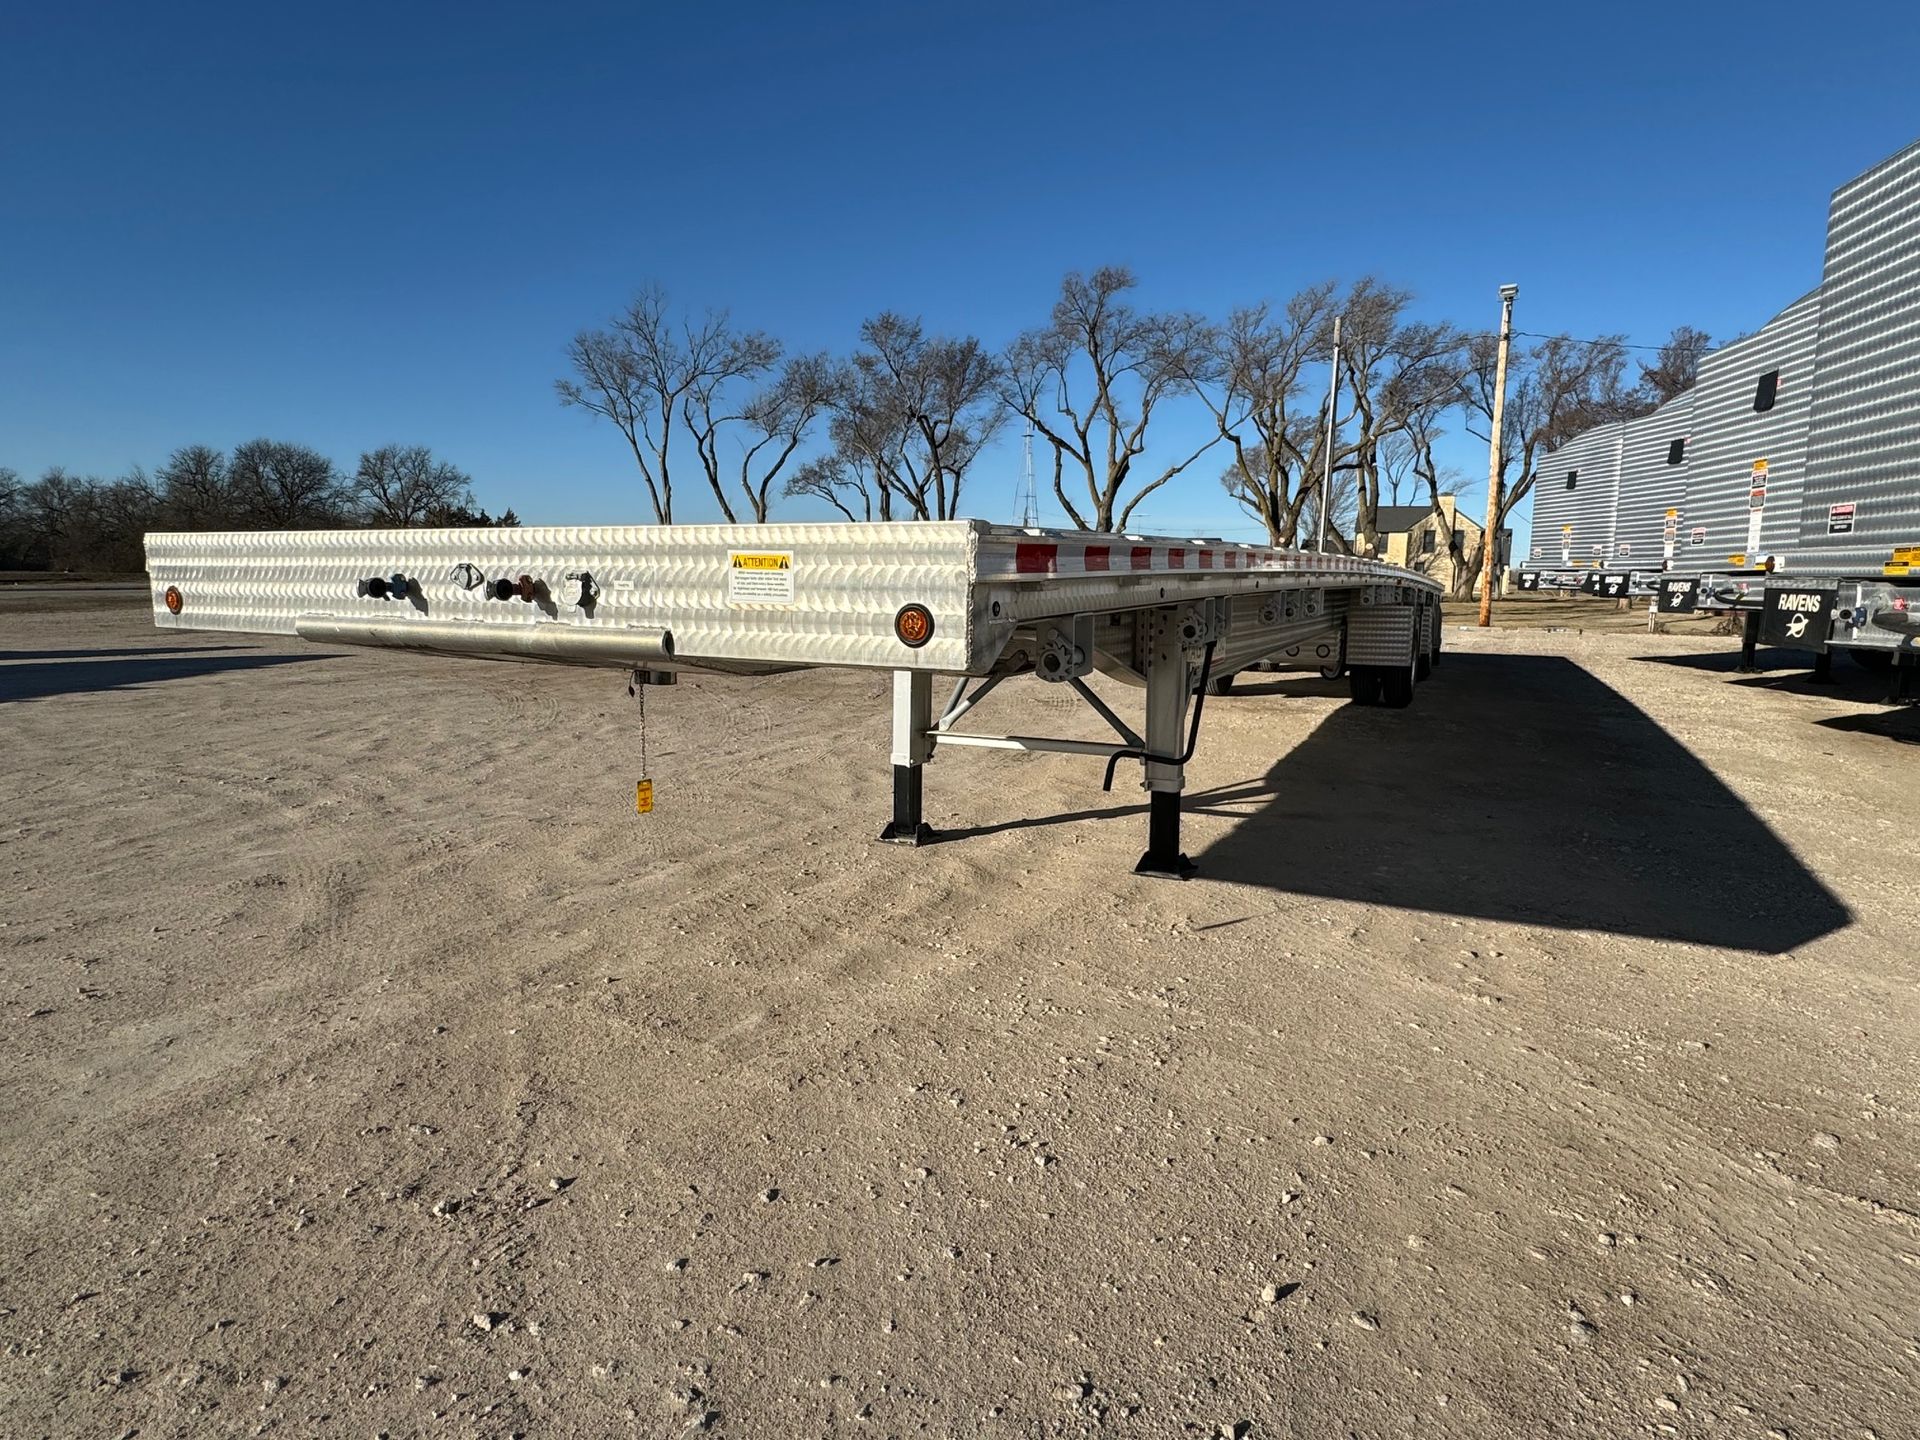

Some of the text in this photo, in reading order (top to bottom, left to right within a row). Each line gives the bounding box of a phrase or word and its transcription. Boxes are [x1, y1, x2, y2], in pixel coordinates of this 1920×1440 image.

[743, 557, 778, 567] ATTENTION
[1667, 582, 1692, 592] RAVENS
[1778, 593, 1821, 612] RAVENS
